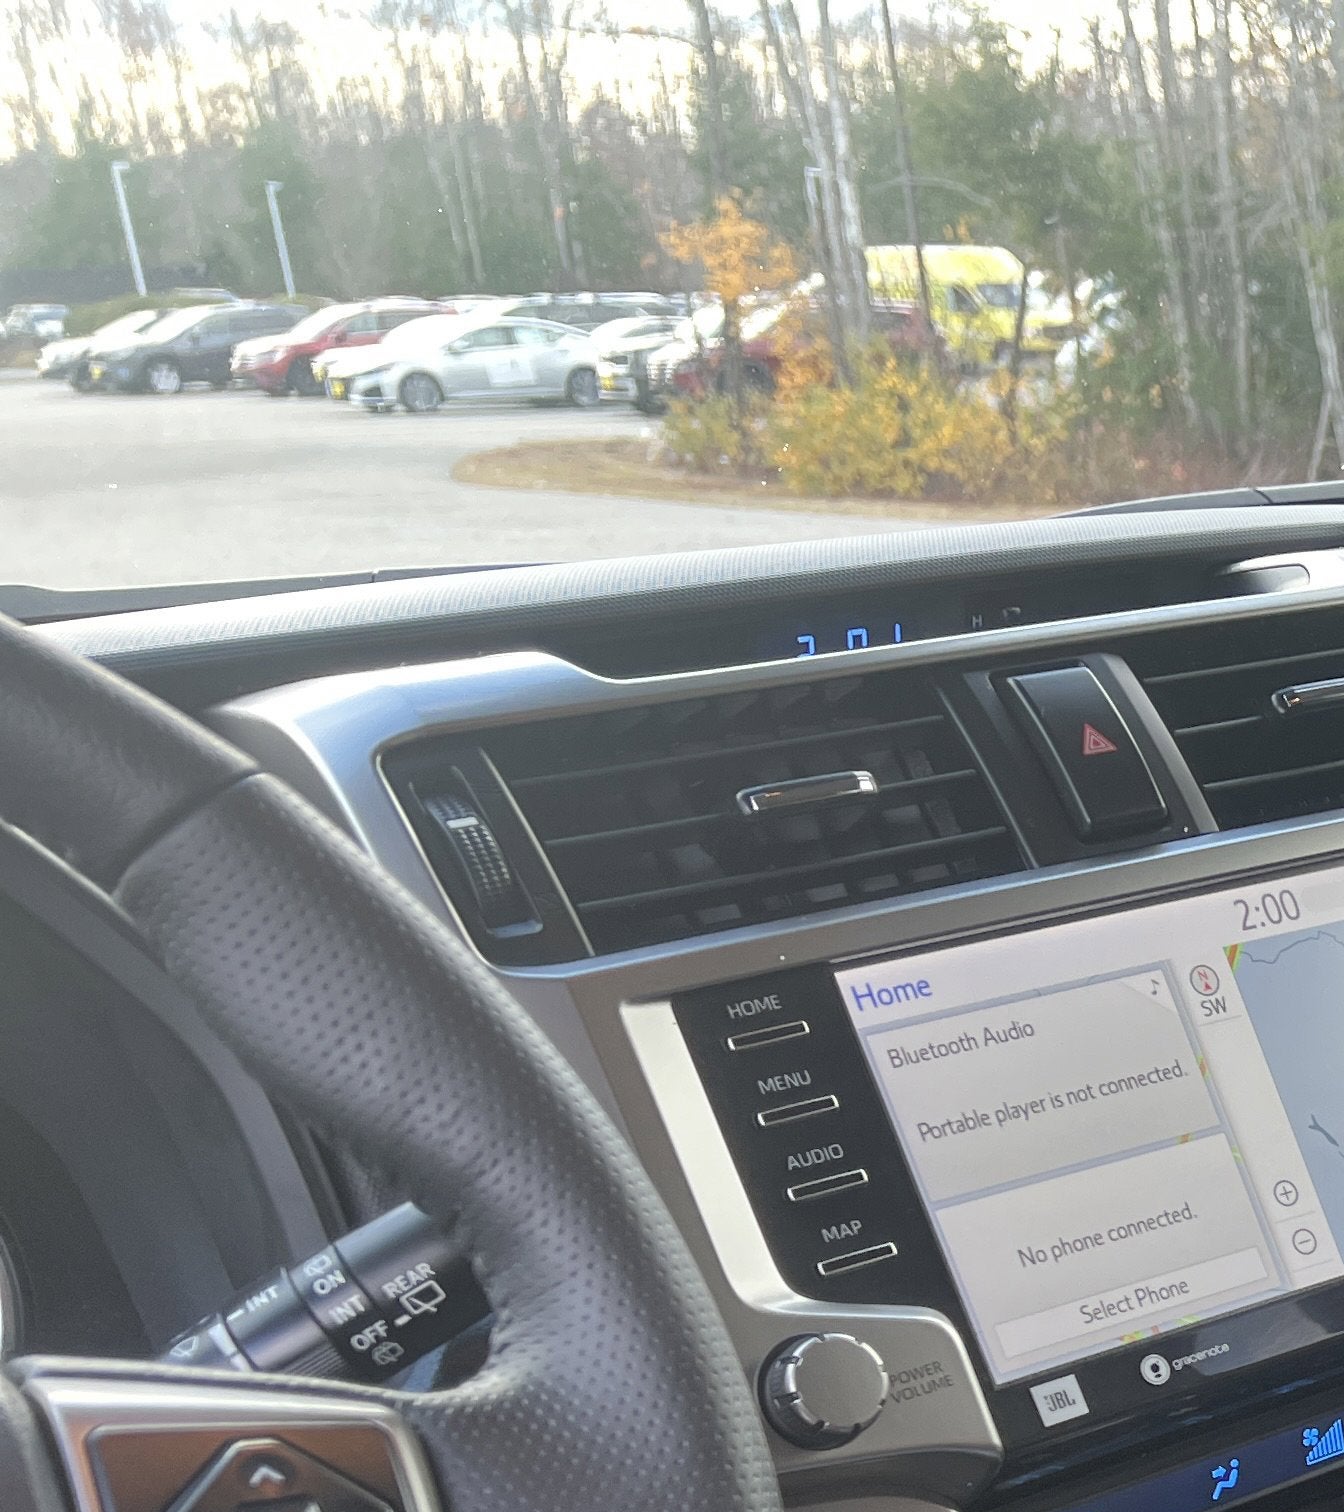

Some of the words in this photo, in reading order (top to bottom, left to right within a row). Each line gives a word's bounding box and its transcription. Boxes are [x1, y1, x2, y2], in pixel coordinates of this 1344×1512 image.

[1233, 890, 1300, 932] 2:00
[727, 995, 781, 1019] HOME
[851, 975, 932, 1012] Home
[1200, 995, 1227, 1017] SW
[887, 1032, 978, 1069] Bluetooth
[982, 1020, 1035, 1046] Audio
[757, 1071, 811, 1095] MENU
[917, 1108, 992, 1142] Portable
[995, 1098, 1045, 1130] player
[1048, 1092, 1063, 1108] is
[1066, 1082, 1097, 1104] not
[1099, 1059, 1189, 1098] connected.
[786, 1143, 844, 1171] AUDIO
[821, 1219, 863, 1243] MAP
[1017, 1248, 1048, 1268] No
[1052, 1230, 1105, 1262] phone
[1108, 1202, 1198, 1242] connected.
[313, 1270, 346, 1295] ON
[382, 1262, 436, 1299] REAR
[246, 1285, 279, 1312] INT
[330, 1295, 366, 1324] INT
[1079, 1294, 1131, 1325] Select
[1135, 1277, 1190, 1306] Phone
[350, 1319, 389, 1350] OFF
[1171, 1340, 1230, 1371] gracenote
[889, 1360, 944, 1389] POWER
[890, 1375, 954, 1404] VOLUME
[1043, 1389, 1077, 1412] JBL
